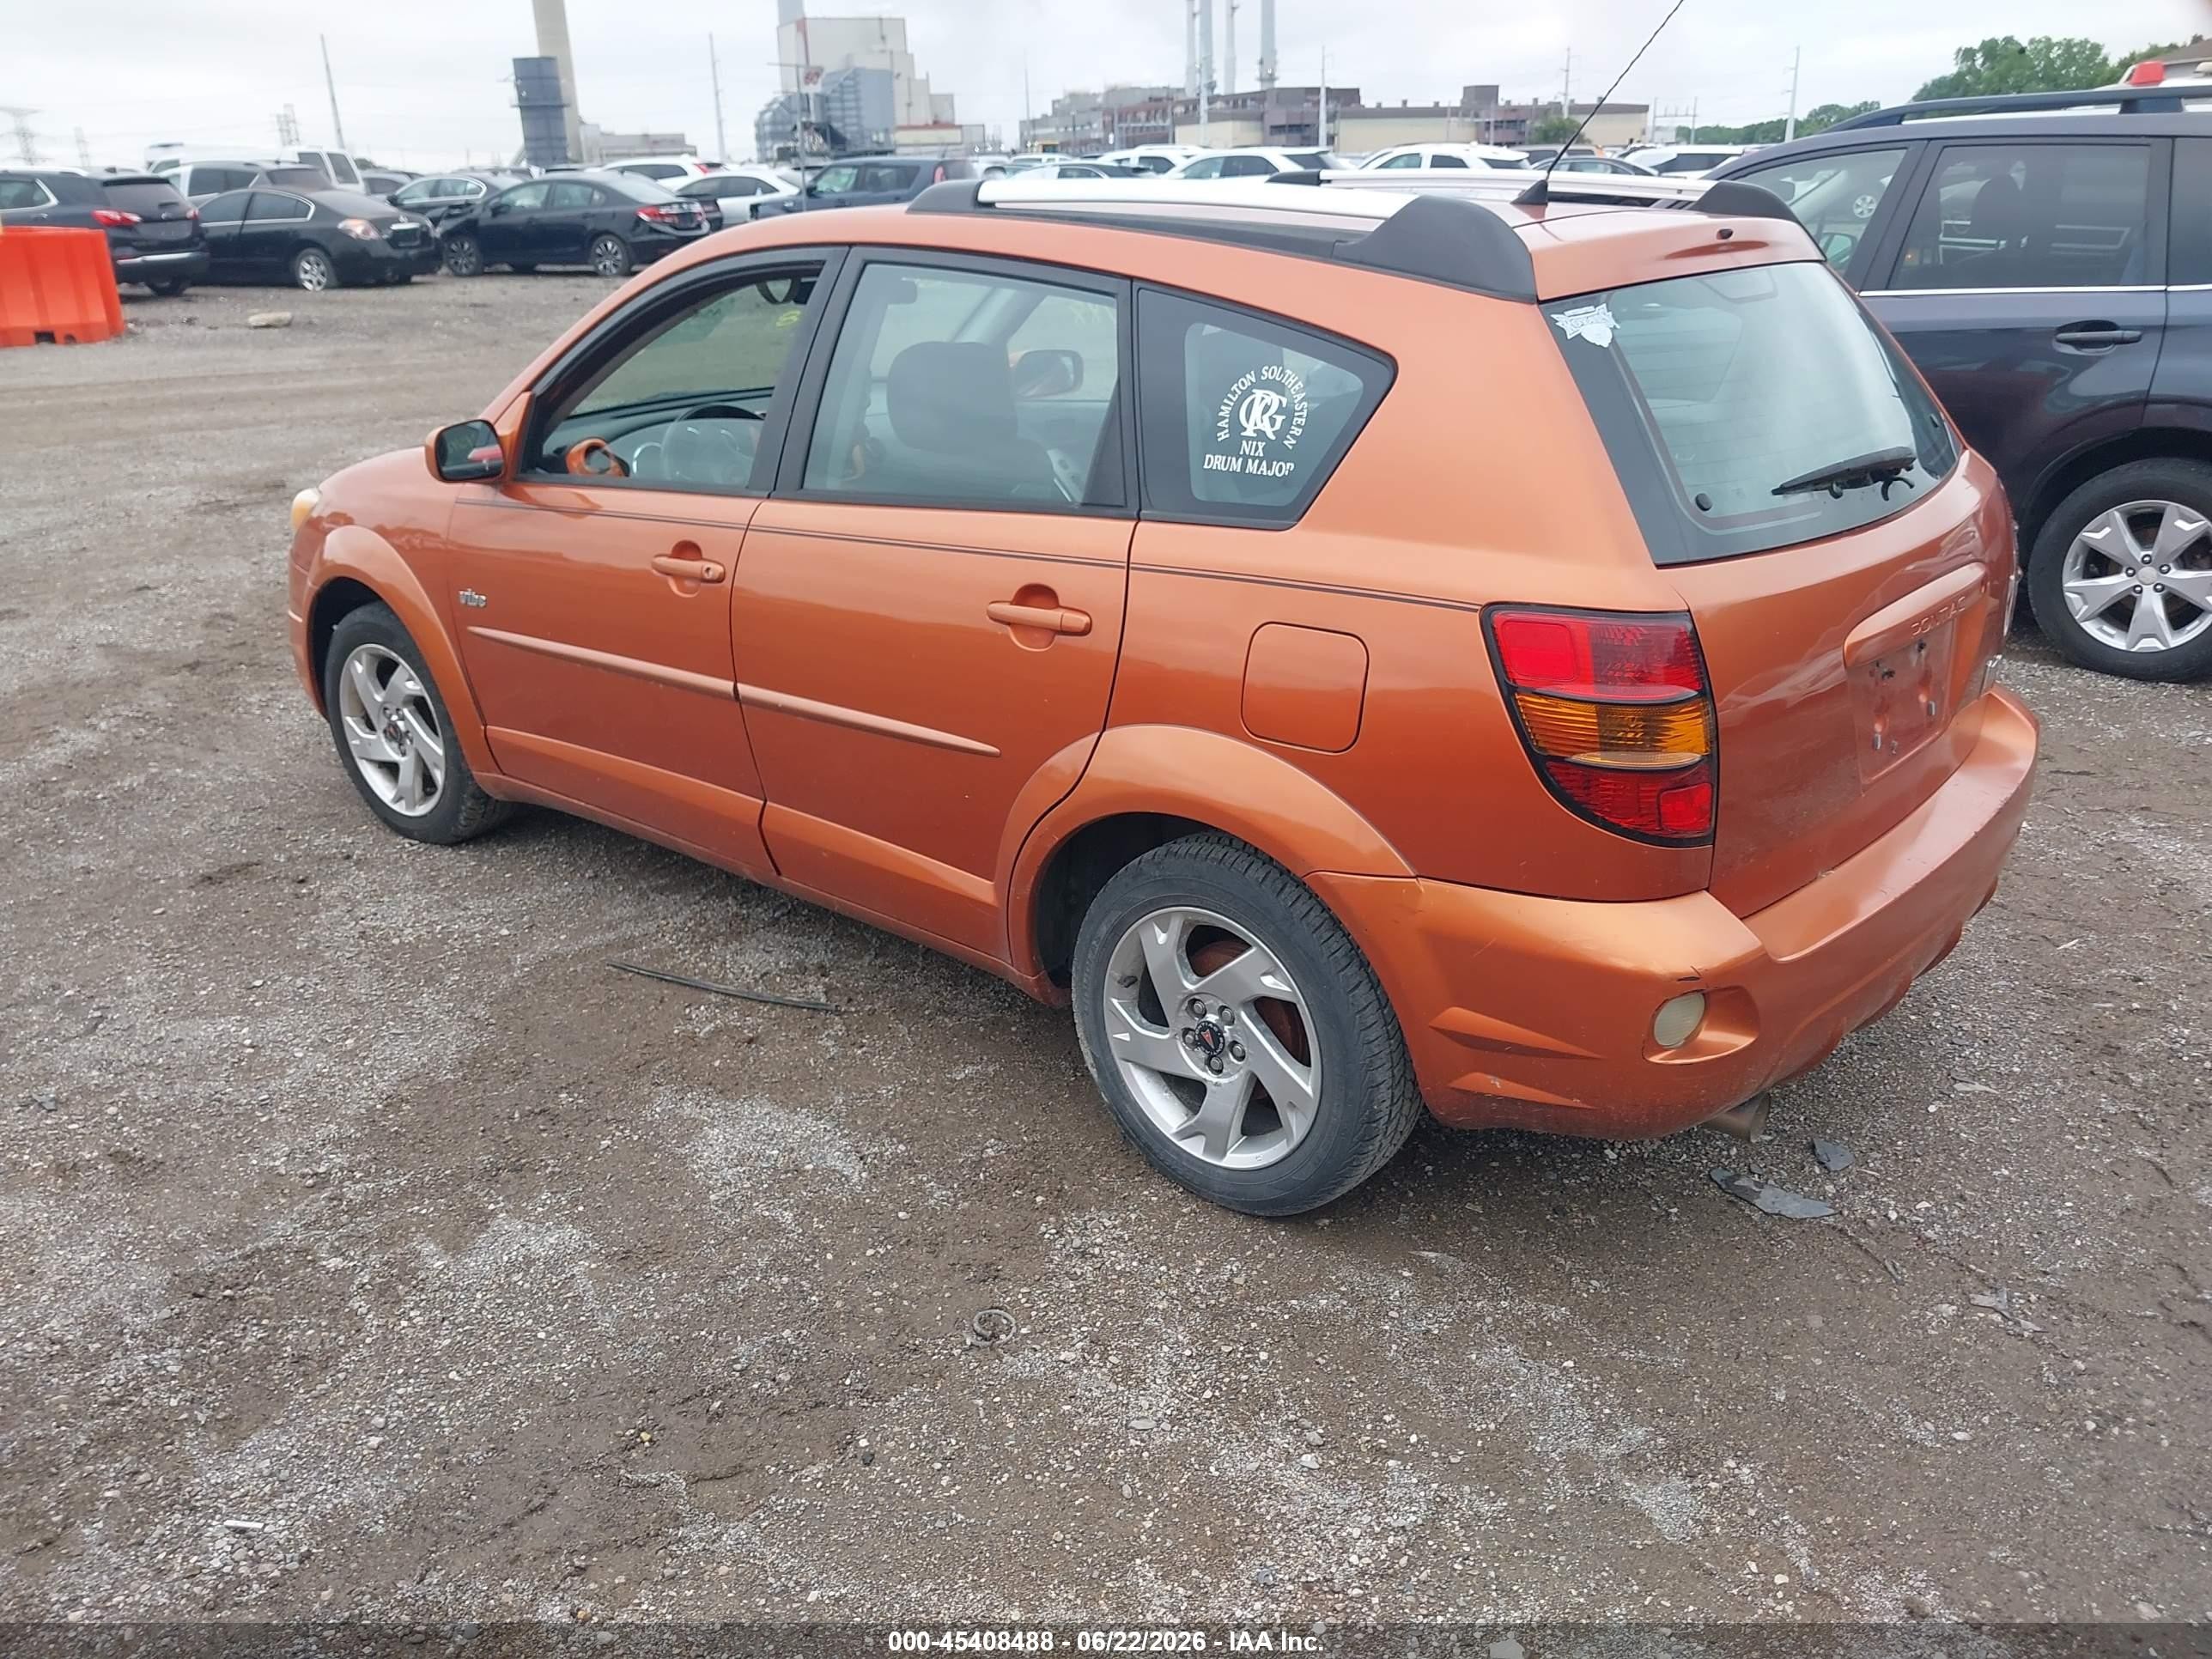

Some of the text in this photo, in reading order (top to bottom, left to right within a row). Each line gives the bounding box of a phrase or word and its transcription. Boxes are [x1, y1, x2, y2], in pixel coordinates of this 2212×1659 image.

[1216, 365, 1308, 450] HAMILTON SOUTHEASTERN
[1239, 440, 1266, 457] NIX
[1203, 453, 1243, 472] DRUM
